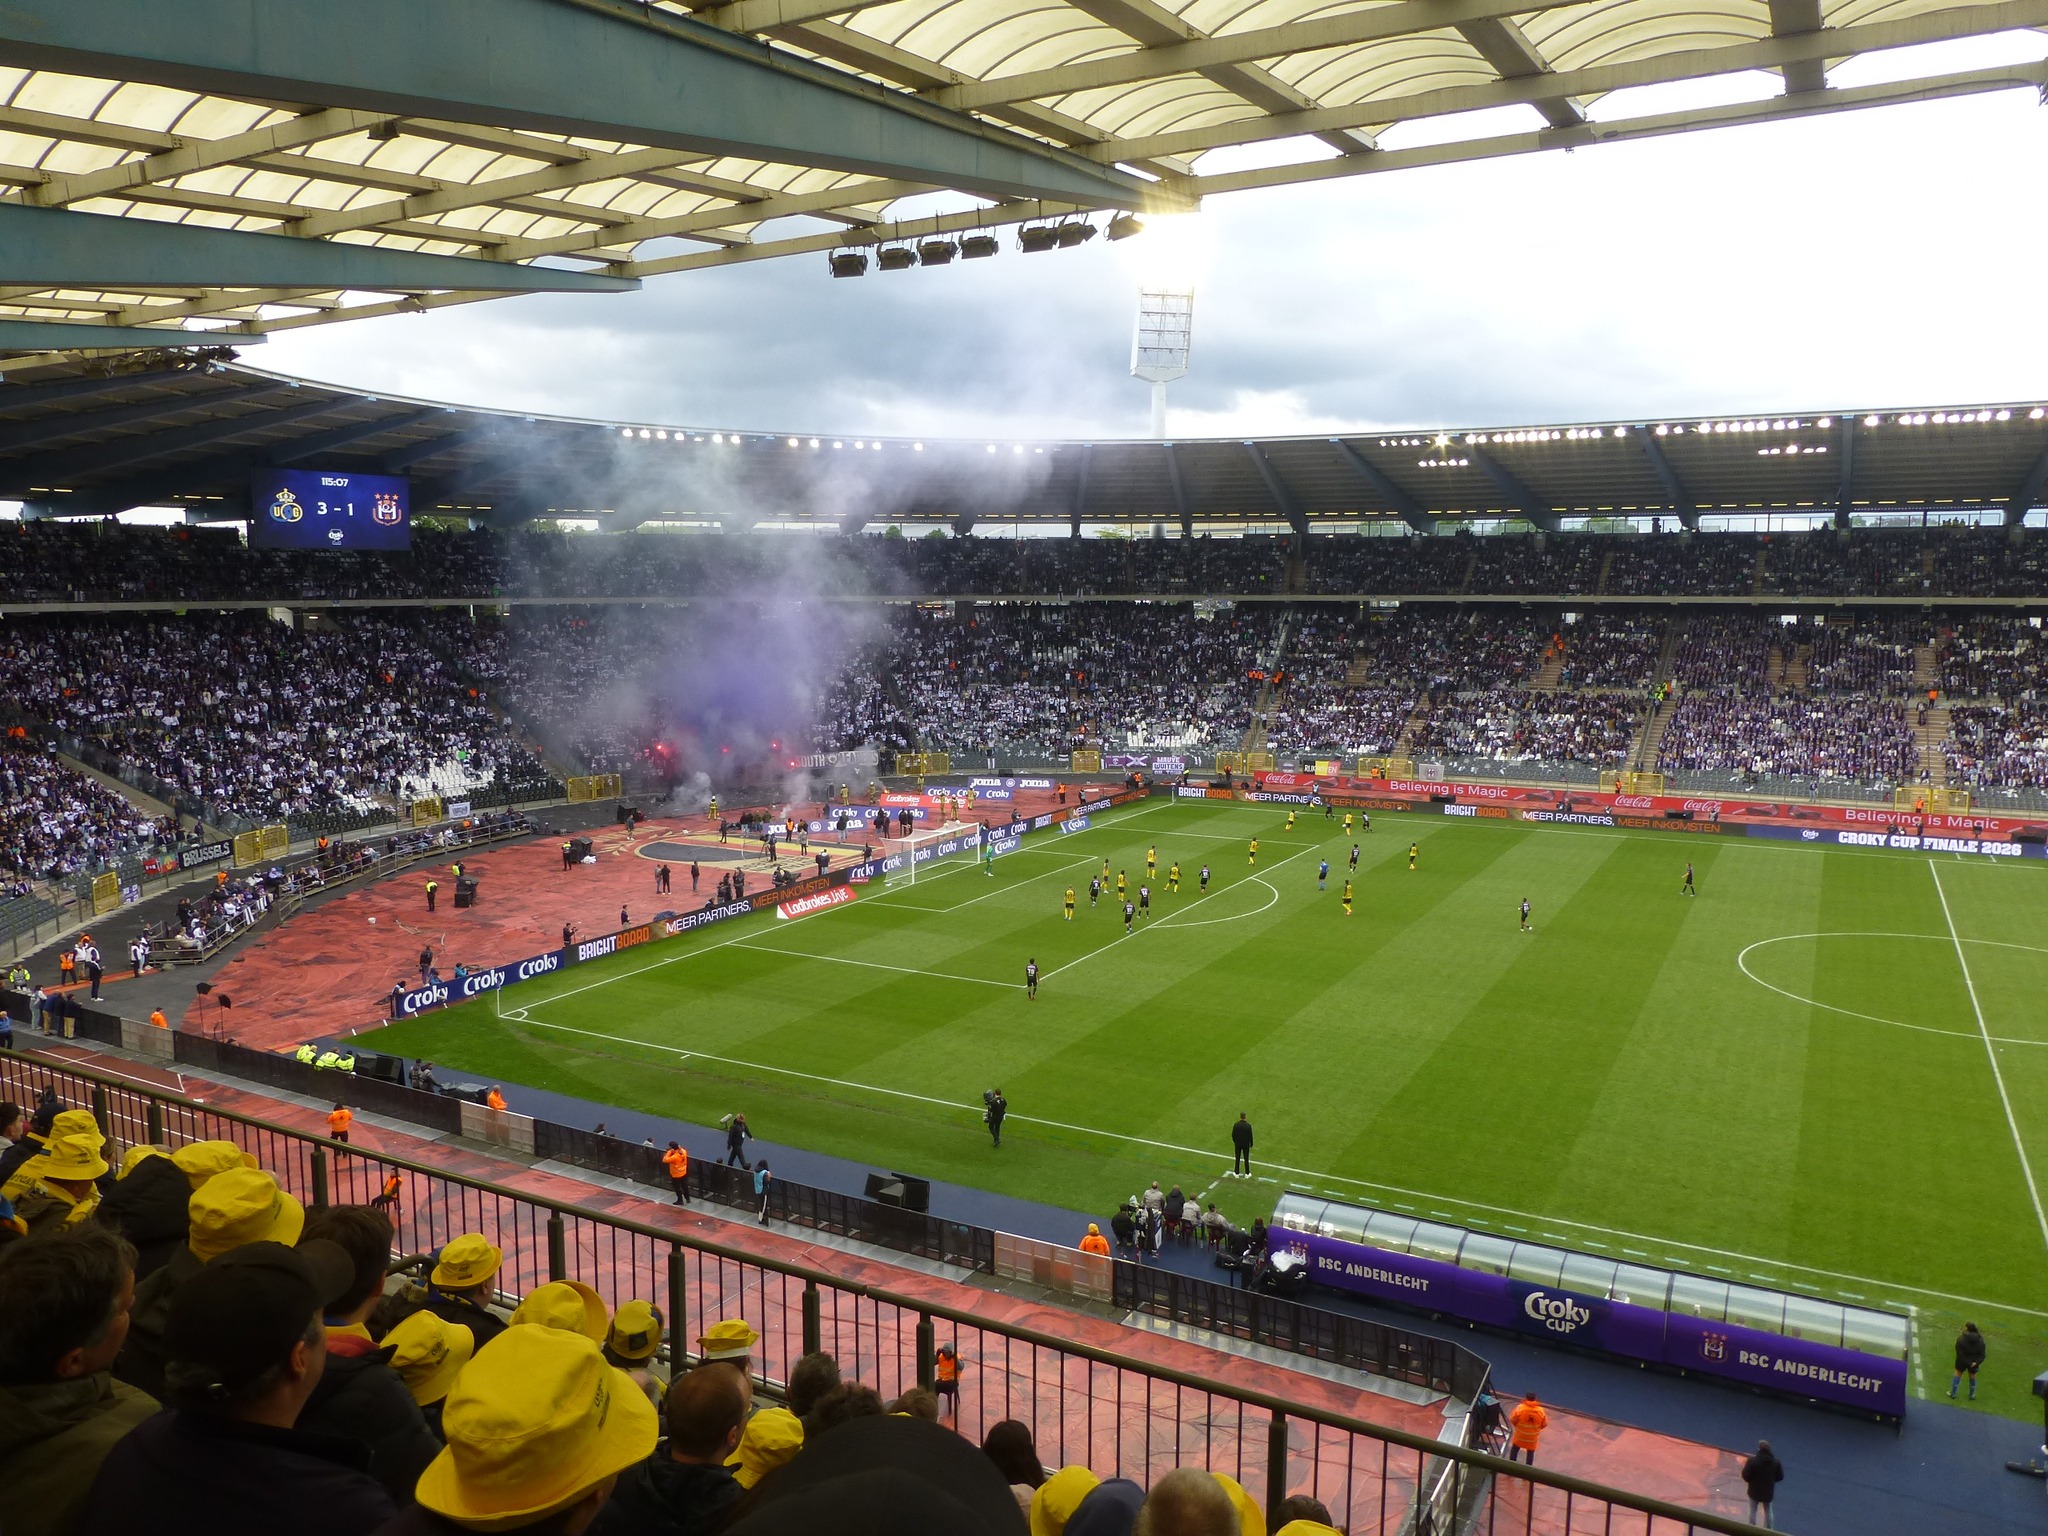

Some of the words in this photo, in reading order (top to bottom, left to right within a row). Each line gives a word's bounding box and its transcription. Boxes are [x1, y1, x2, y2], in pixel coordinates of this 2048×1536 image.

[322, 478, 348, 487] 115:07
[317, 502, 327, 515] 3
[348, 503, 354, 516] 1
[986, 790, 1010, 798] Croky
[1178, 787, 1232, 799] BRIGHTBOARD
[1390, 781, 1449, 795] Believing
[1454, 784, 1463, 794] is
[1469, 786, 1508, 798] Magic
[1245, 792, 1271, 801] MEER
[1325, 798, 1352, 807] MEER
[1353, 800, 1411, 810] INKOMSTEN
[1444, 805, 1507, 818] BRIGHTBOARD
[1845, 810, 1922, 826] Believing
[1928, 815, 1941, 825] is
[1947, 816, 1999, 830] Magic
[1011, 821, 1027, 835] Croky
[1068, 818, 1086, 831] Croky
[1522, 810, 1554, 821] MEER
[1556, 814, 1614, 826] PARTNERS,
[1618, 818, 1650, 828] MEER
[1652, 822, 1720, 833] INKOMSTEN
[988, 828, 1006, 842] Croky
[1838, 832, 1887, 846] CROKY
[1890, 834, 1920, 848] CUP
[1923, 838, 1978, 853] FINALE
[1981, 842, 2022, 856] 2026
[183, 842, 230, 867] BRUSSELS
[938, 840, 956, 857] Croky
[994, 838, 1016, 854] Croky
[666, 914, 696, 934] MEER
[699, 900, 752, 925] PARTNERS,
[752, 892, 779, 908] MEER
[781, 878, 830, 901] INKOMSTEN
[578, 927, 649, 961] BRIGHTBOARD
[519, 955, 557, 980] Croky
[464, 968, 505, 995] Croky
[404, 984, 448, 1014] Croky
[1318, 1256, 1342, 1272] RSC
[1346, 1263, 1429, 1291] ANDERLECHT
[1524, 1291, 1589, 1325] Croky
[1545, 1320, 1576, 1333] CUP
[1739, 1350, 1769, 1368] RSC
[1774, 1359, 1882, 1393] ANDERLECHT
